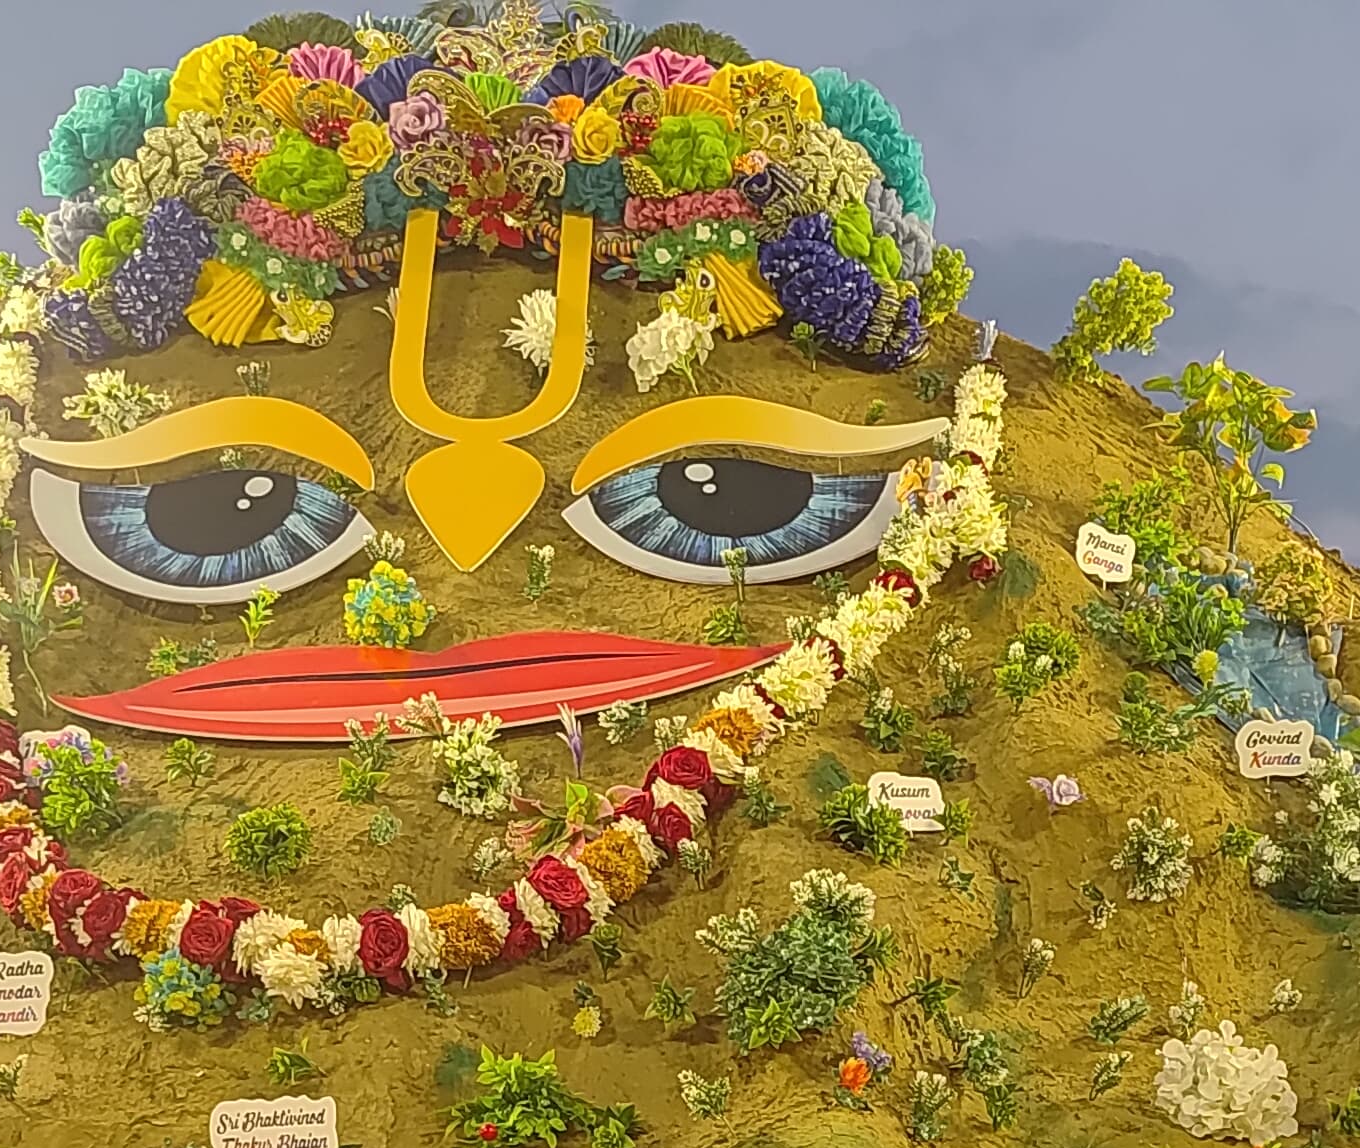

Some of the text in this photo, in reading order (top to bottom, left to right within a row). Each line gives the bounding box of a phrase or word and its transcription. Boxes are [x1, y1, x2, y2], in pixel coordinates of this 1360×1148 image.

[1086, 532, 1127, 555] Mansi
[1082, 550, 1124, 573] Ganga
[1246, 730, 1303, 748] Govind
[1249, 751, 1302, 768] Kunda
[878, 783, 931, 801] Kusum
[216, 1108, 326, 1135] Sri Bhaktivinod
